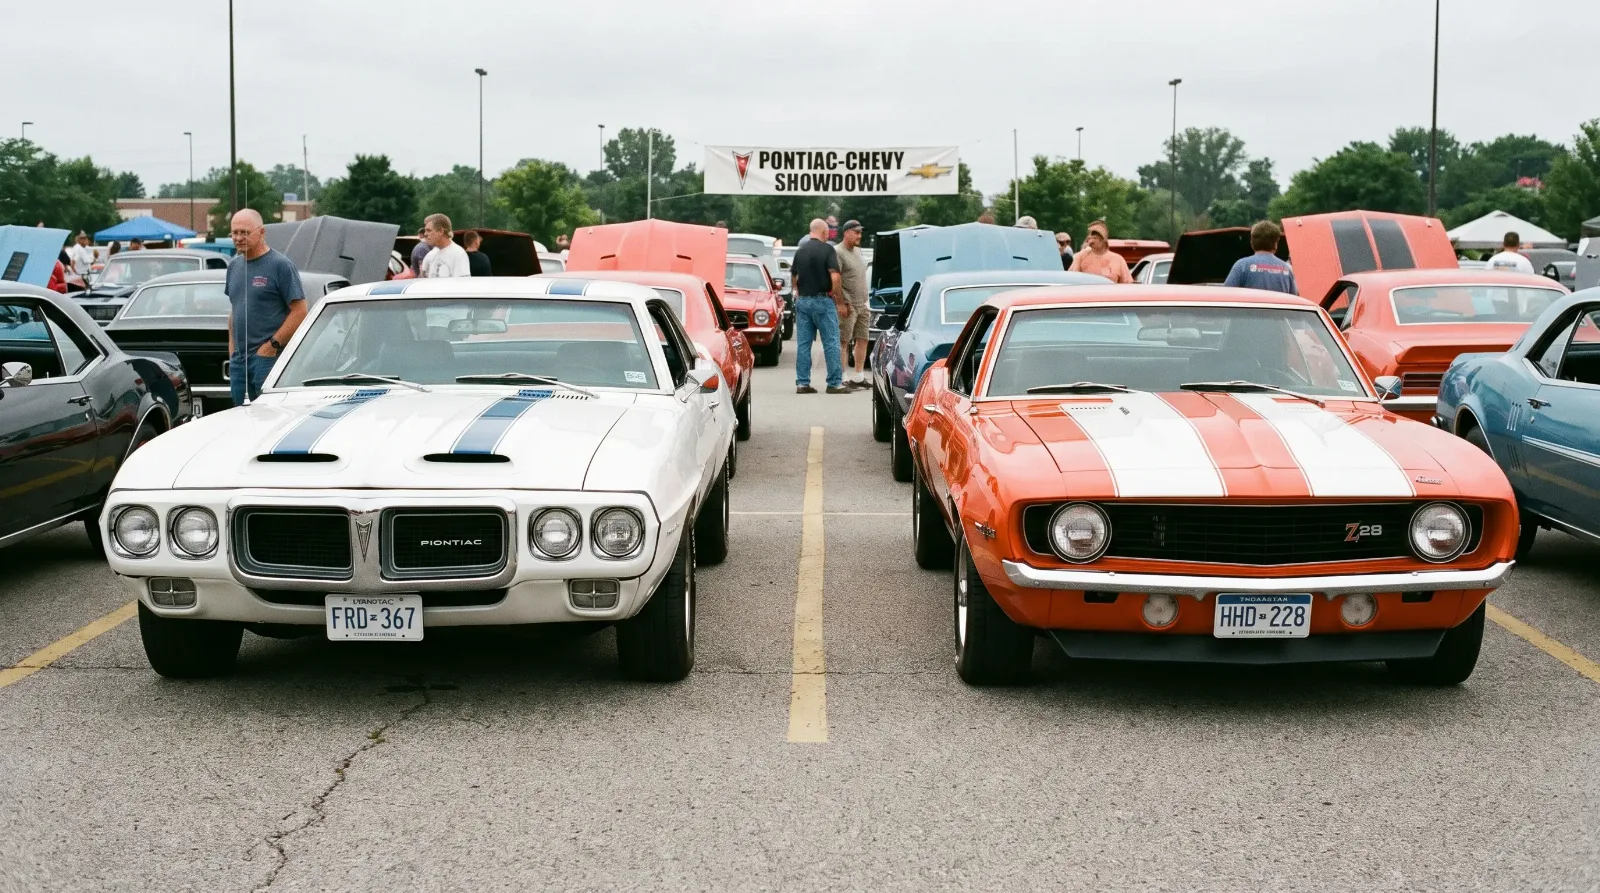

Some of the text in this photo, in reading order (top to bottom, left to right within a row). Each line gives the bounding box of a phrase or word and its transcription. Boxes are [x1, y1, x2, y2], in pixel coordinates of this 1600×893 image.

[759, 150, 905, 171] PONTIAC-CHEVY
[775, 172, 888, 192] SHOWDOWN
[1343, 522, 1383, 543] Z28
[331, 606, 416, 629] FRD 367
[1220, 605, 1306, 627] HHD 228
